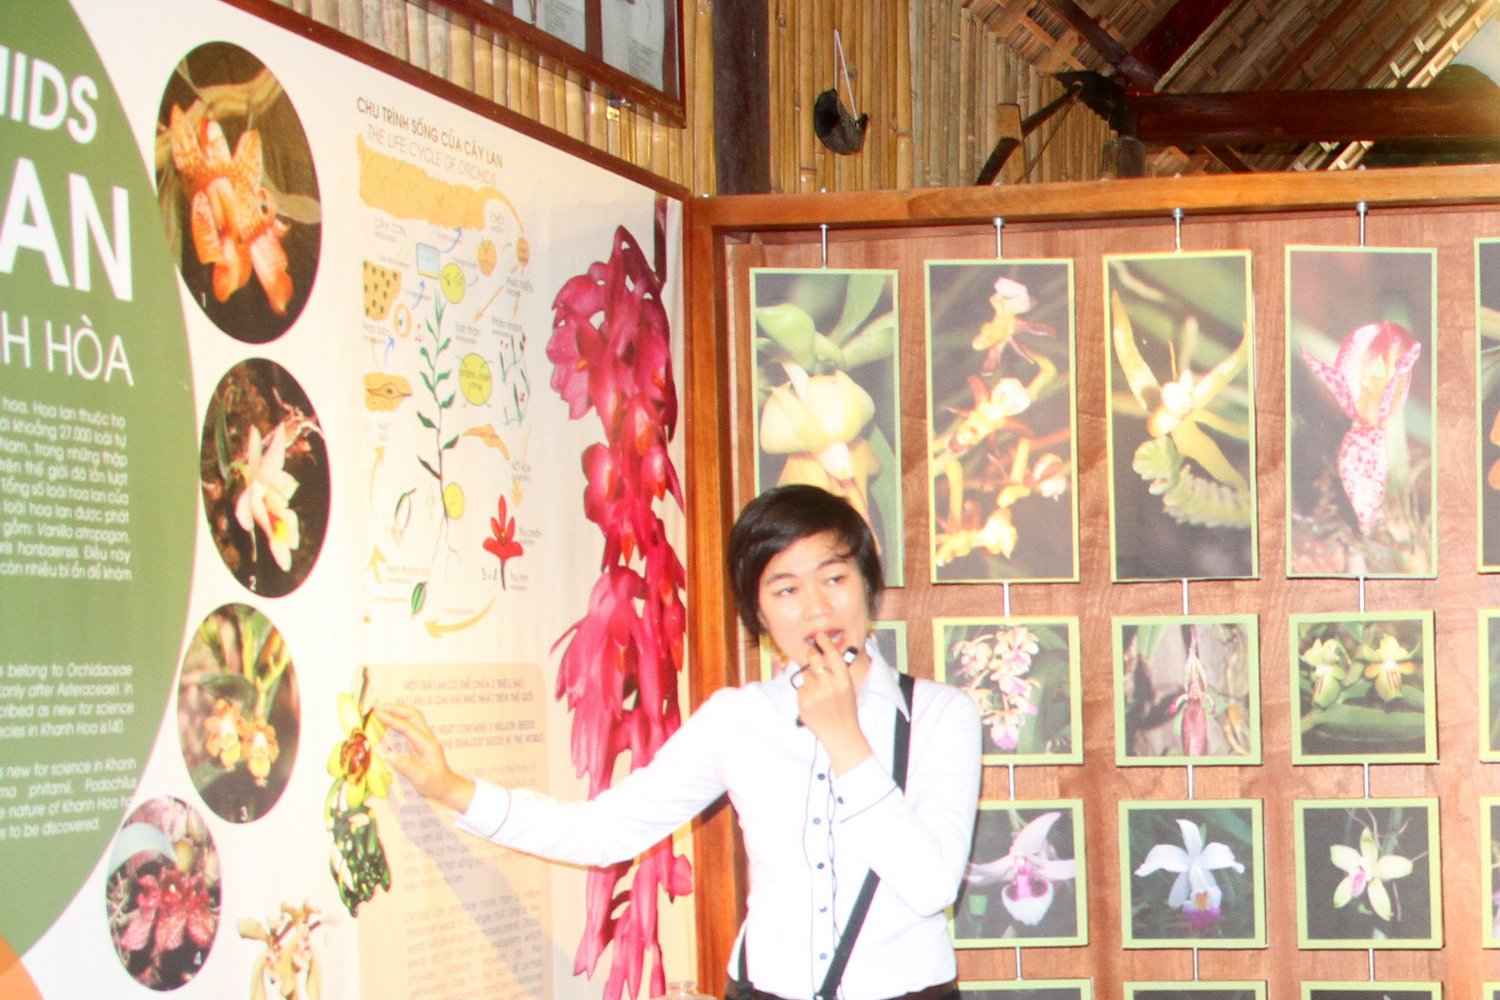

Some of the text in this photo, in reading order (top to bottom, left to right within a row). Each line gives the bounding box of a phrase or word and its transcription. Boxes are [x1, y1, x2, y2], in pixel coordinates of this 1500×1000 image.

[0, 43, 98, 145] IDS
[408, 141, 441, 167] CYCLE
[46, 313, 134, 388] HÒA
[8, 662, 48, 682] belong
[51, 662, 64, 677] to
